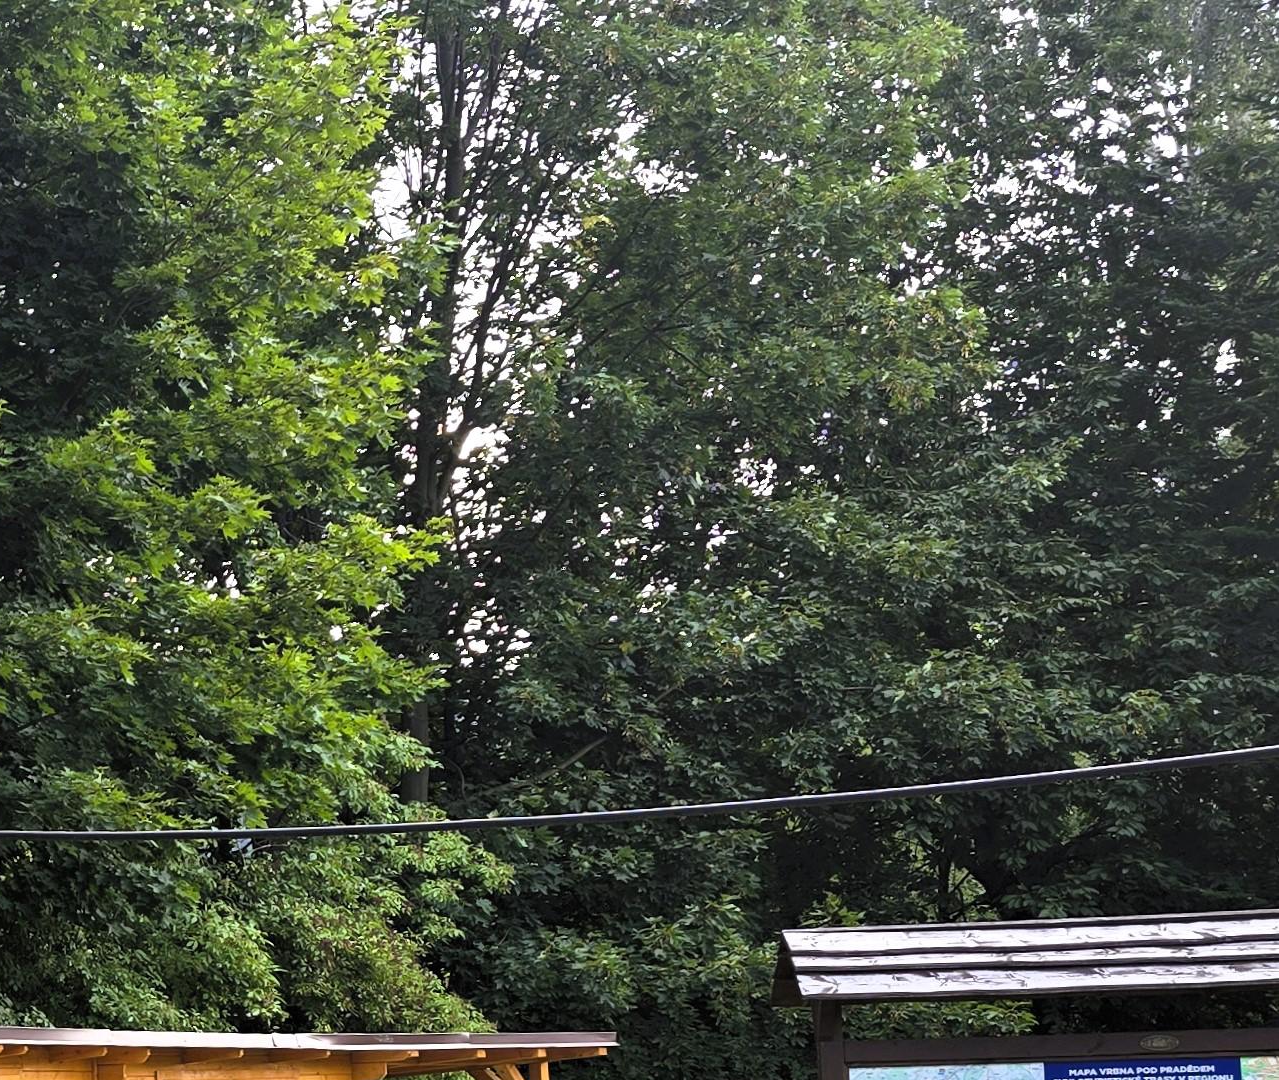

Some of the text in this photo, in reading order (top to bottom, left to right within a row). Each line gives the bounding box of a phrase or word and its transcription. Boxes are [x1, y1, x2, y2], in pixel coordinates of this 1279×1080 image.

[1068, 1064, 1215, 1077] MAPA VRBNA POD PRADĚDEM
